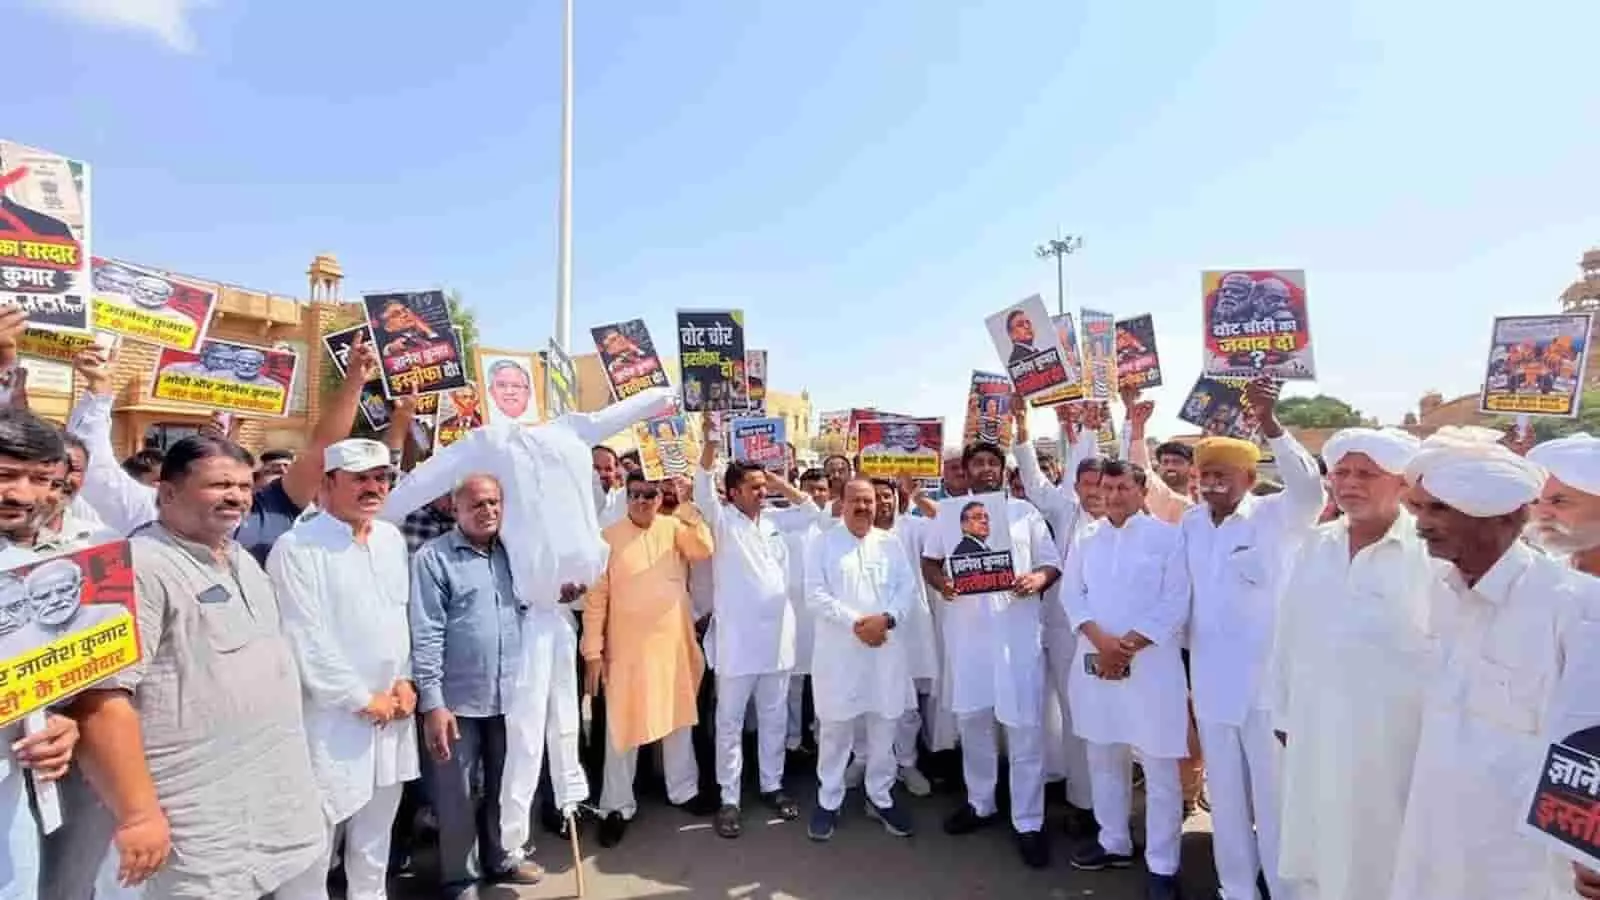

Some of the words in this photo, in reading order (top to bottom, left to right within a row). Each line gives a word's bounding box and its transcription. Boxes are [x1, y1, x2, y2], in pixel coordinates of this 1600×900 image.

[20, 241, 77, 265] सरदार
[3, 266, 56, 288] कुमार
[680, 321, 705, 347] वोट
[707, 321, 734, 347] चोर
[1213, 319, 1240, 337] वोट
[1242, 317, 1276, 335] चोरी
[1278, 319, 1297, 332] का
[1217, 335, 1271, 352] जवाब
[1273, 332, 1297, 351] दो
[1250, 350, 1265, 369] ?
[79, 622, 129, 657] कुमार
[34, 679, 54, 699] के
[57, 648, 127, 689] साझेदार
[1548, 753, 1600, 797] ज्ञाने
[1536, 792, 1600, 849] इस्ती
